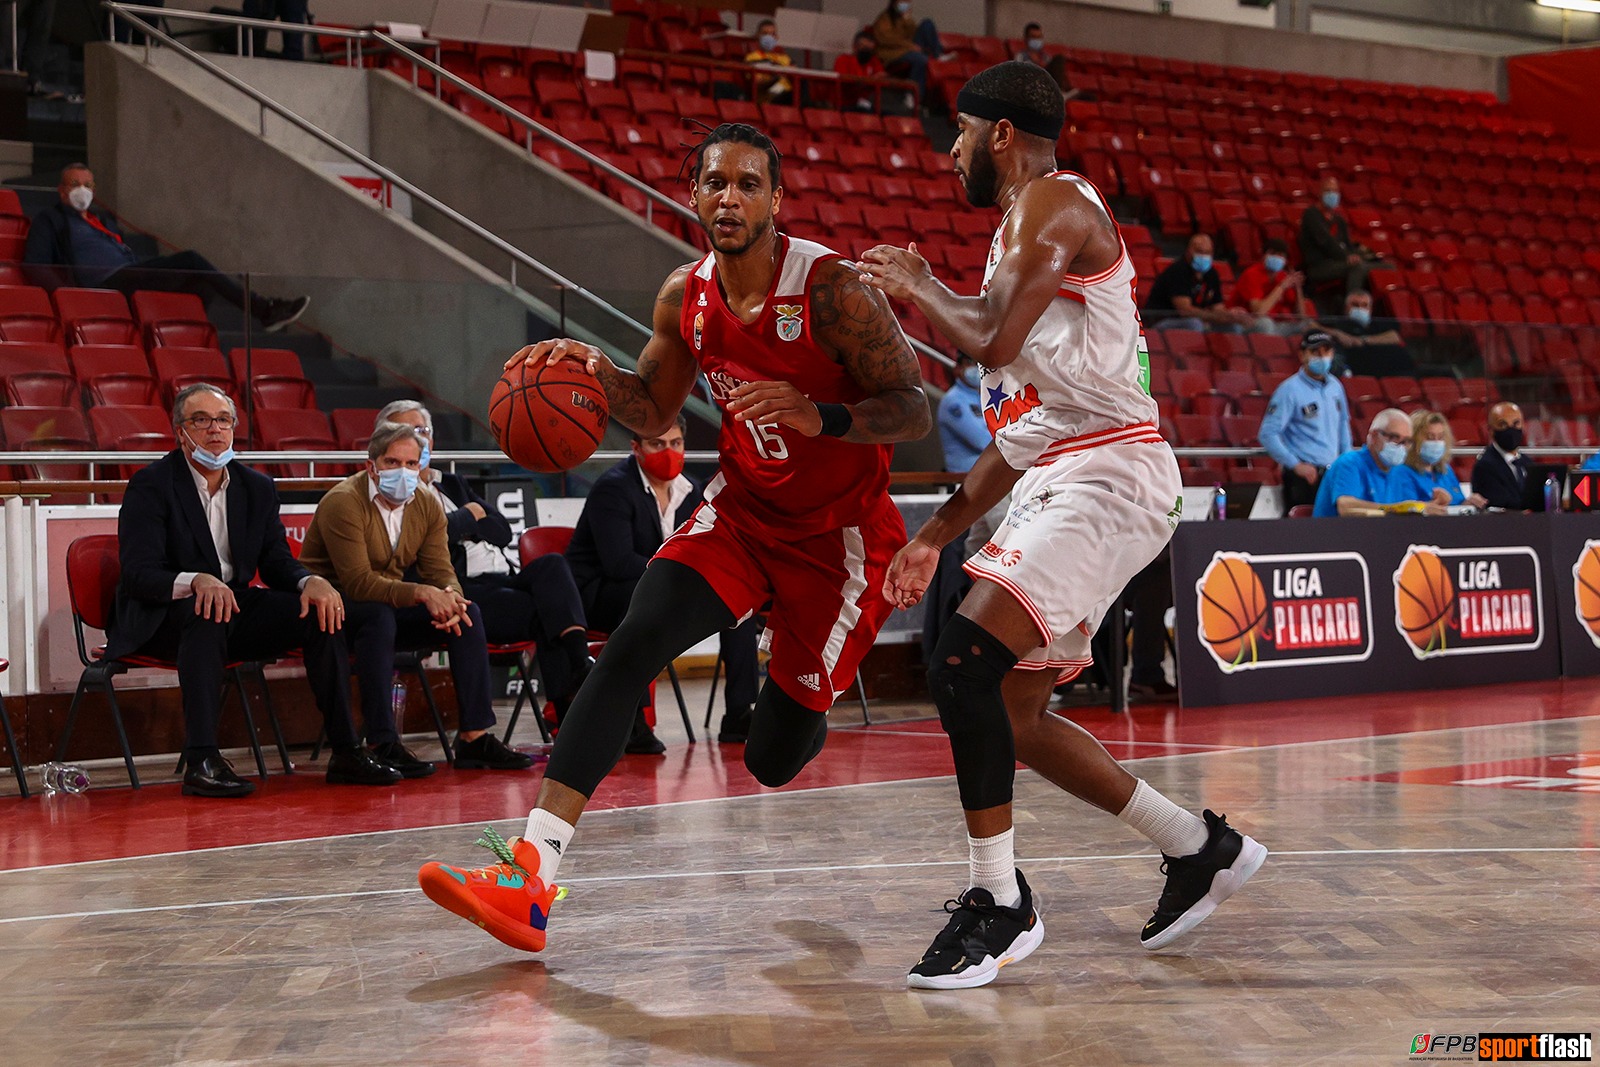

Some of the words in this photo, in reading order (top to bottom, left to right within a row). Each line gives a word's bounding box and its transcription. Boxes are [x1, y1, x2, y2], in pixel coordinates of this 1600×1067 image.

[745, 419, 789, 460] 15
[1272, 567, 1323, 598] LIGA
[1458, 560, 1502, 589] LIGA
[1273, 602, 1361, 645] PLACARD
[1458, 593, 1533, 634] PLACARD
[797, 675, 821, 692] adidas
